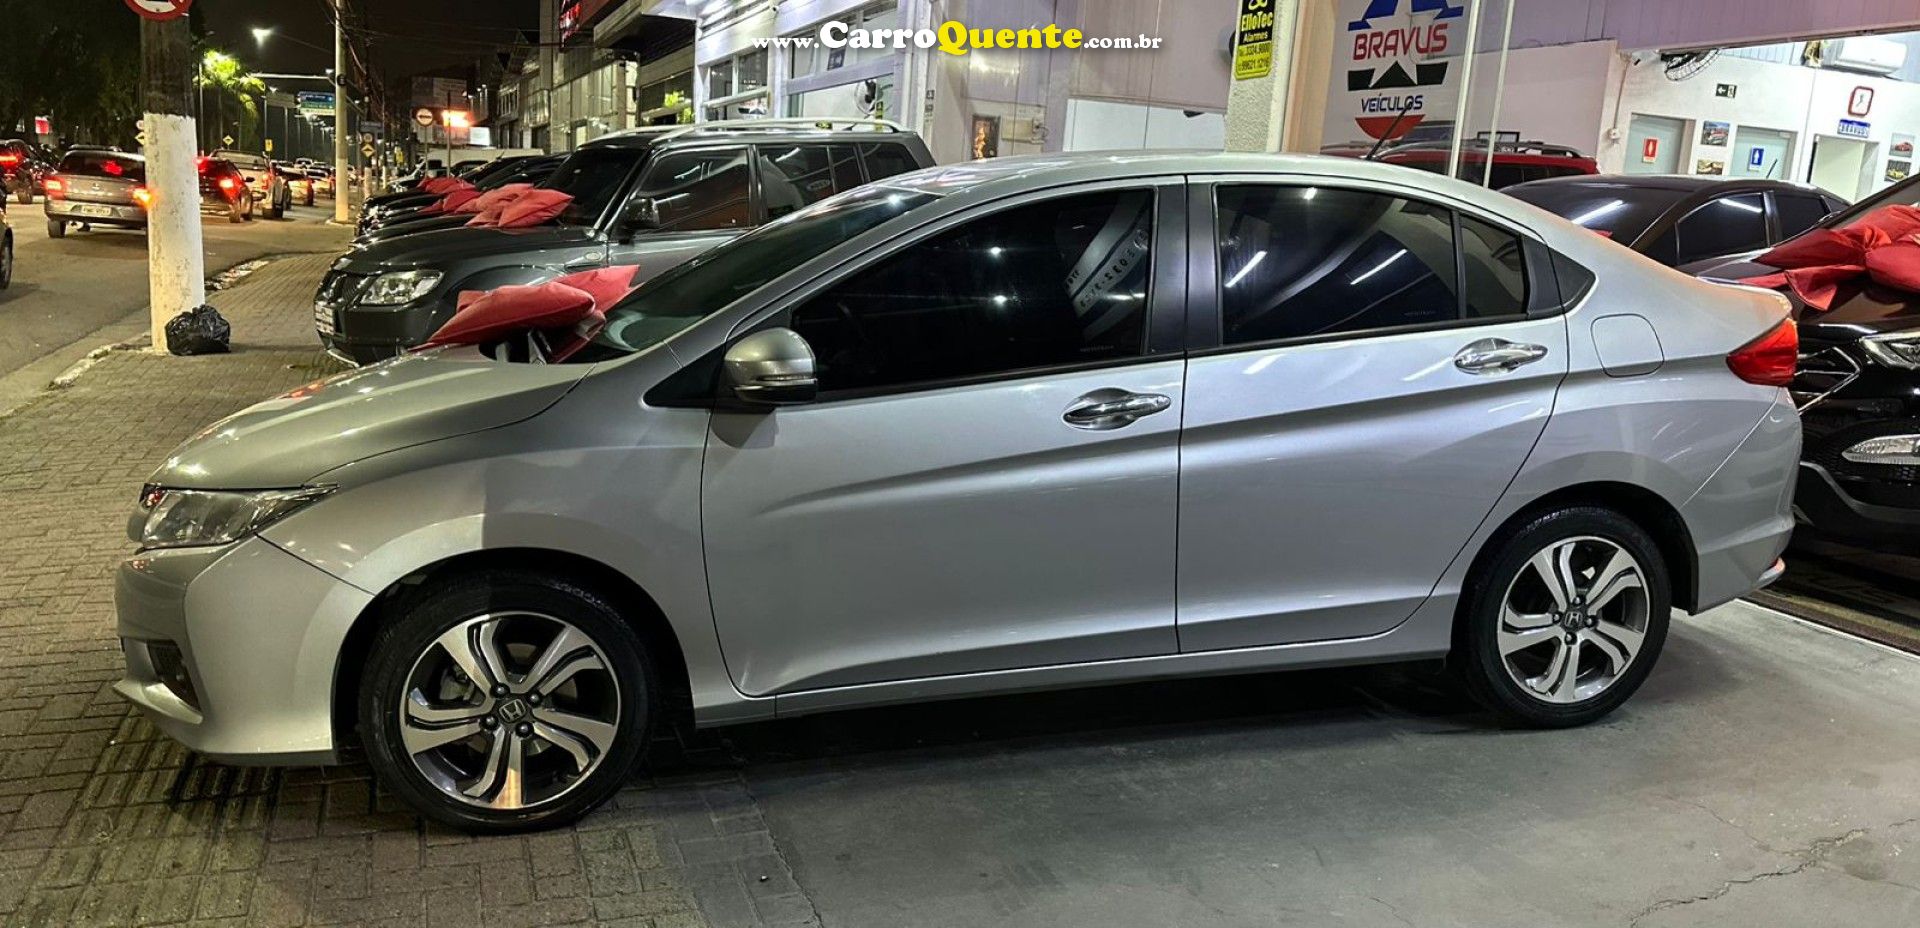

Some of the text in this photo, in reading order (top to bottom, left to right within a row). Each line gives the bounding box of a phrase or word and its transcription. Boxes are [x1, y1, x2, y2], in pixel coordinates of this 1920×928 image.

[1244, 31, 1268, 43] Alarmes
[1353, 23, 1448, 61] BRAVUS
[1361, 93, 1424, 113] VEÍCULOS
